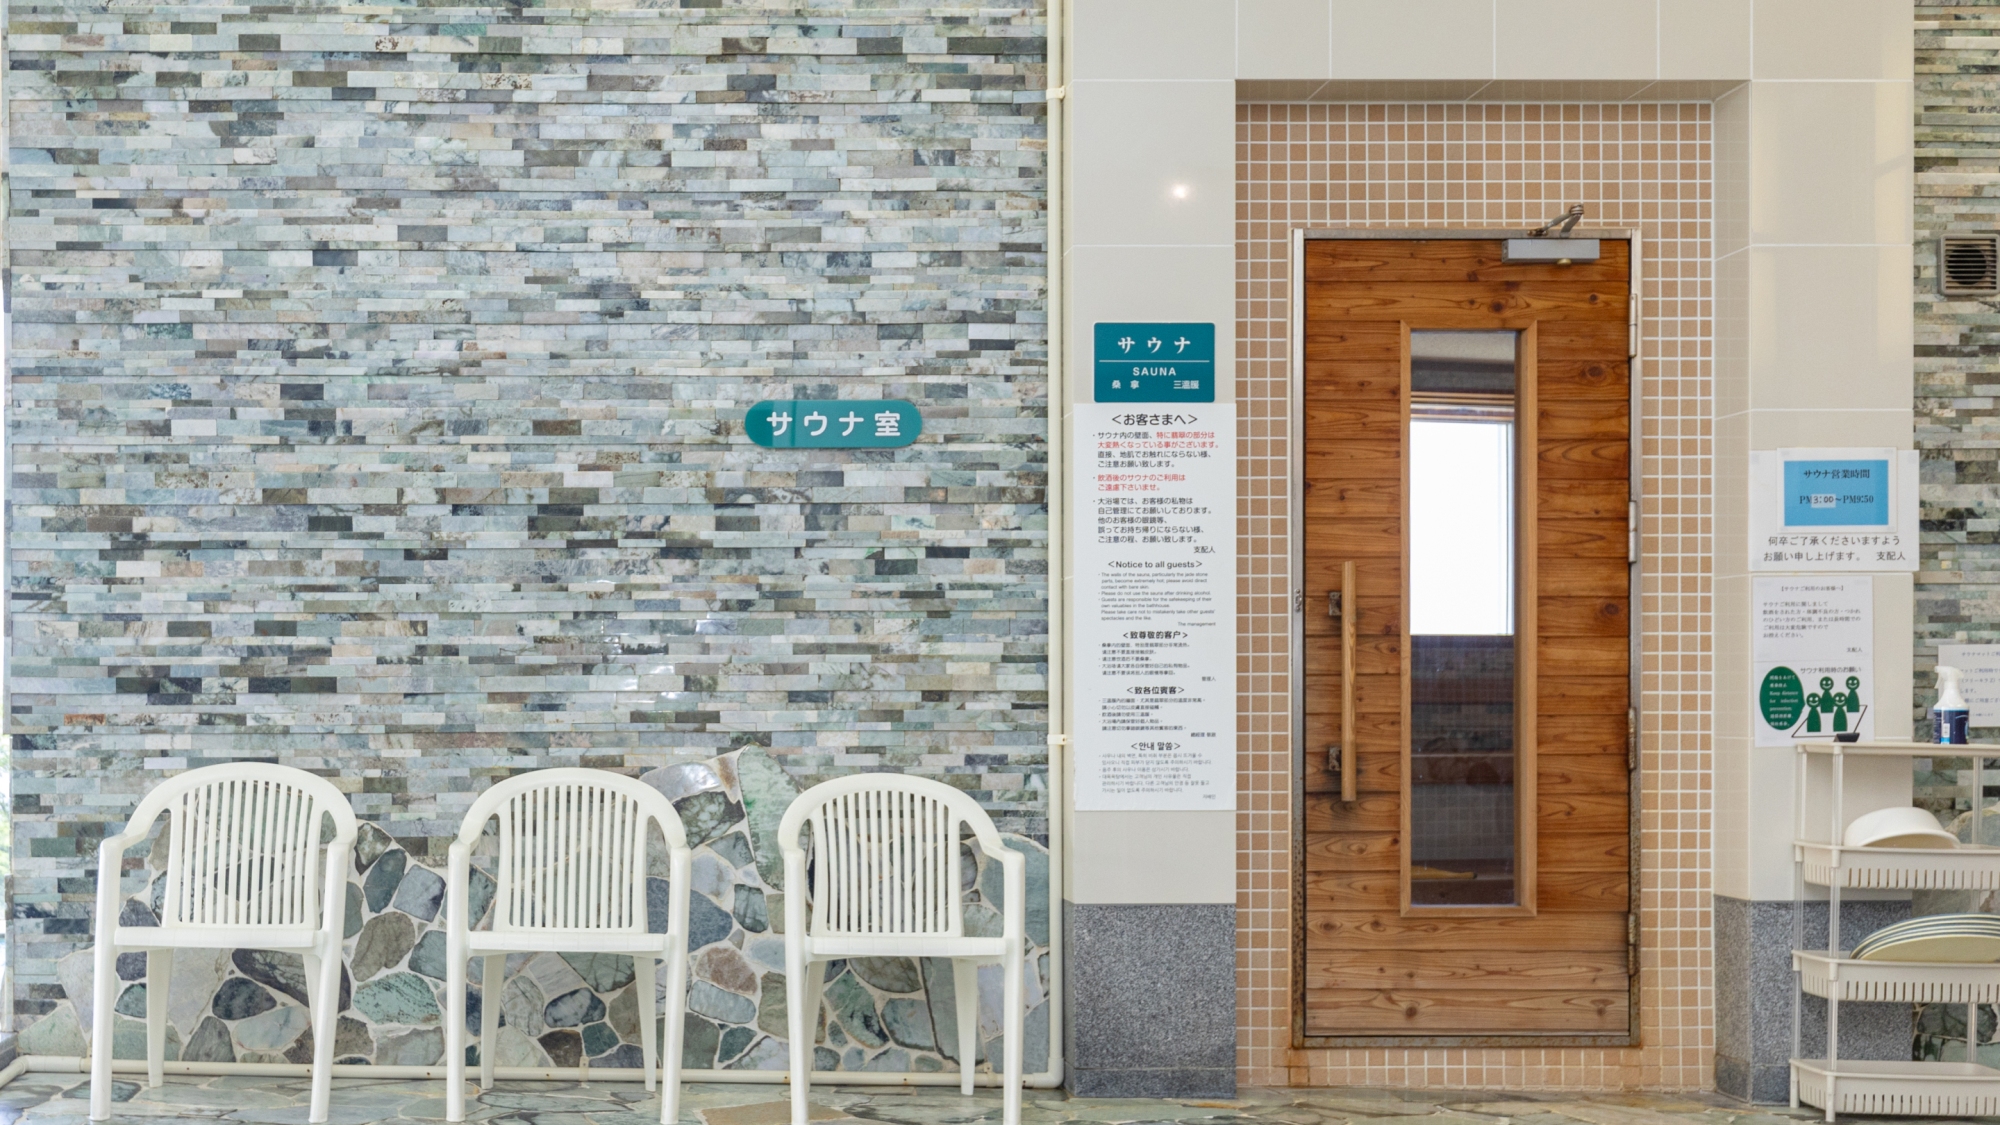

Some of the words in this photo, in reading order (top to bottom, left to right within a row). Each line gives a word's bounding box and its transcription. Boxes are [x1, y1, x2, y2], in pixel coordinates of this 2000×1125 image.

[1117, 336, 1191, 354] サウナ
[1133, 367, 1177, 376] SAUNA
[766, 410, 901, 436] サウナ室
[1098, 441, 1219, 449] 大変熱くなっている事がございます。
[1098, 474, 1186, 482] 飲酒後のサウナのご利用は
[1803, 469, 1870, 479] サウナ営業時間
[1098, 497, 1193, 505] 大浴場では、お客様の私物は
[1768, 536, 1900, 546] 何卒ご了承くださいますよう
[1193, 546, 1216, 554] 支配人
[1764, 551, 1861, 561] お願い申し上げます。
[1876, 551, 1906, 561] 支配人
[1800, 666, 1862, 674] サウナ利用時のお願い
